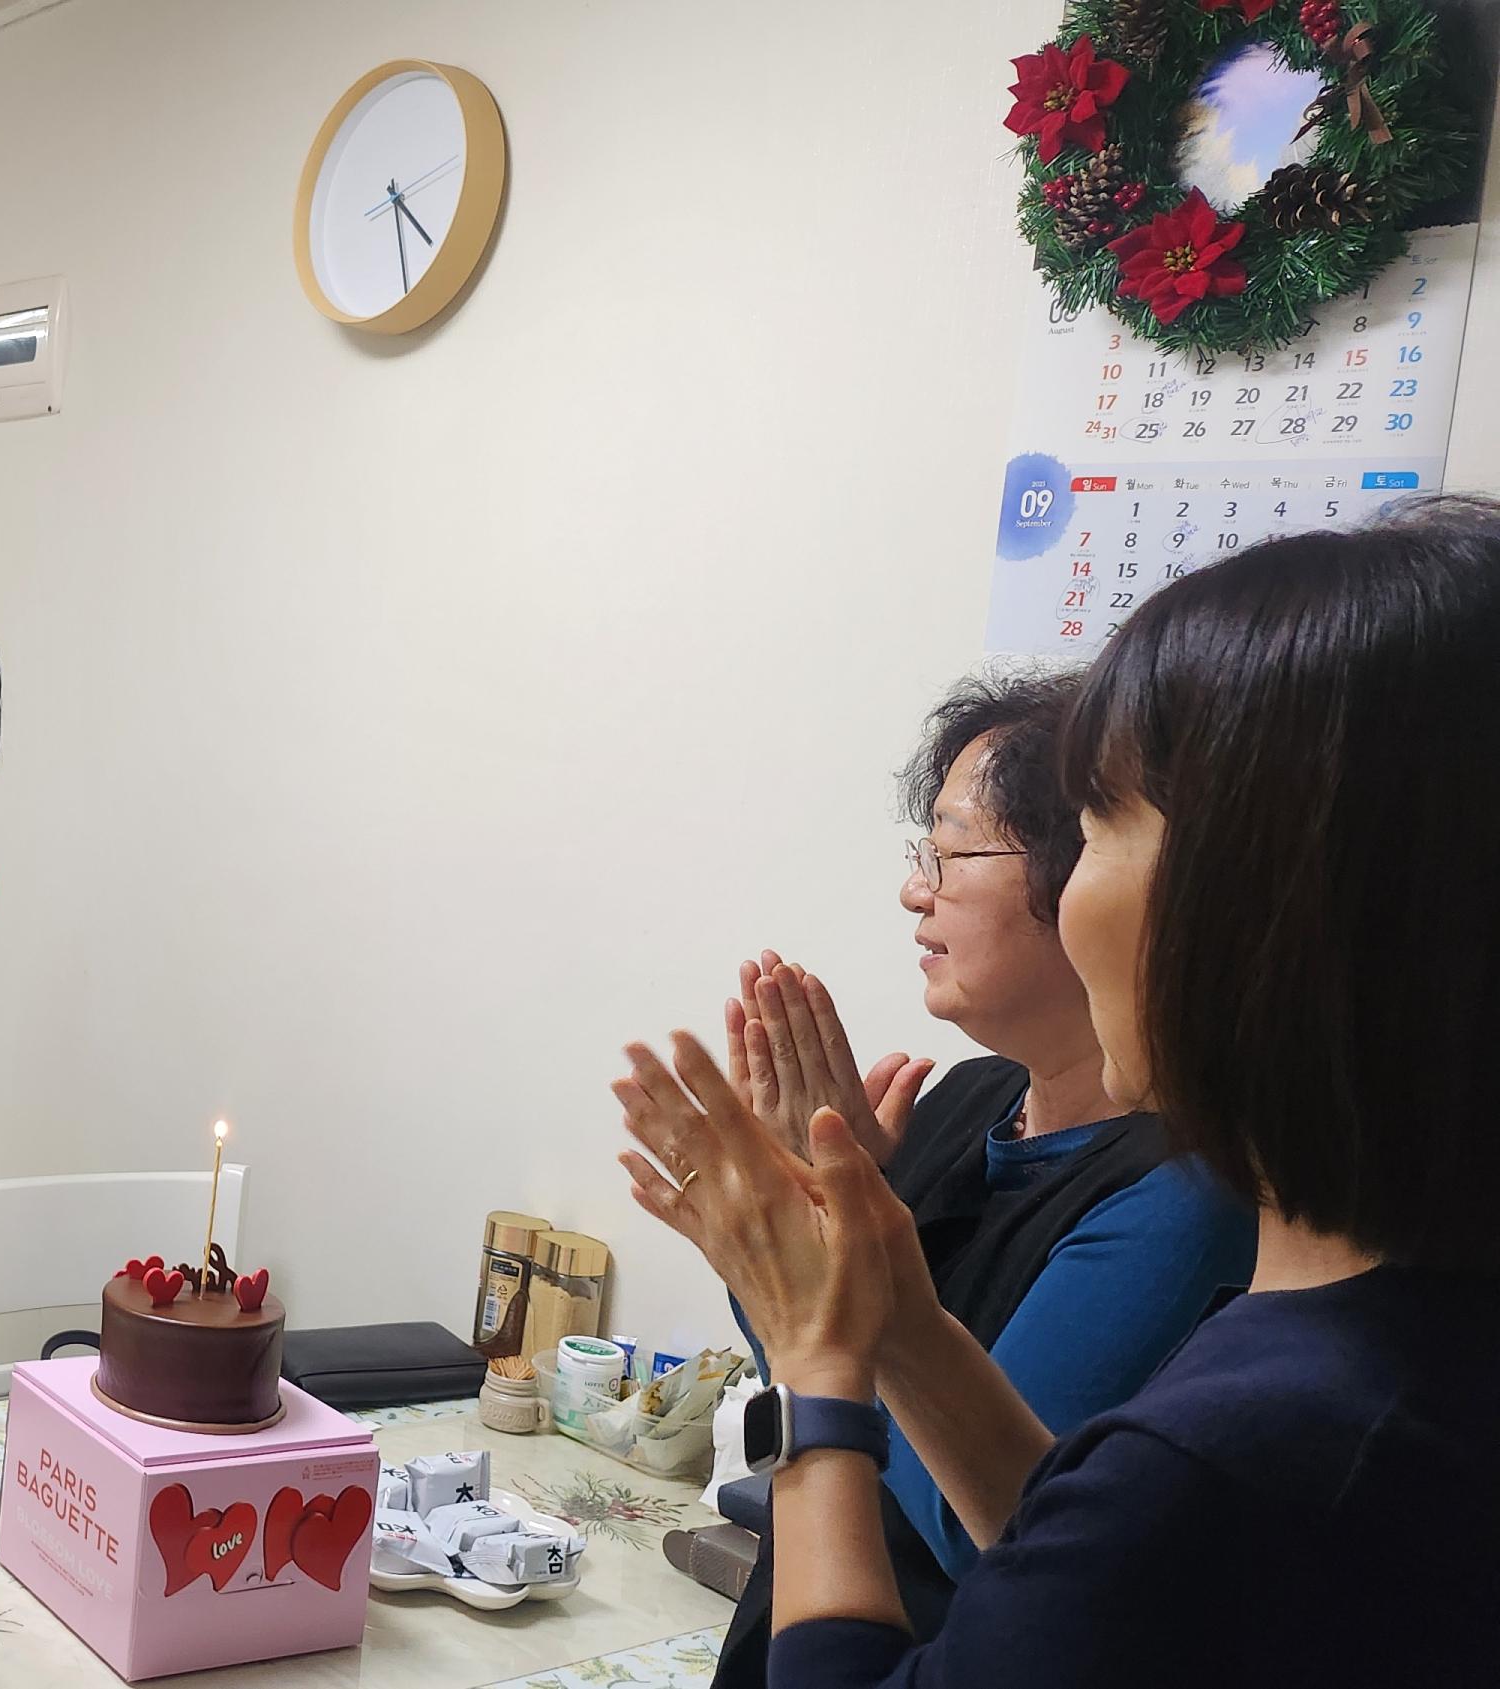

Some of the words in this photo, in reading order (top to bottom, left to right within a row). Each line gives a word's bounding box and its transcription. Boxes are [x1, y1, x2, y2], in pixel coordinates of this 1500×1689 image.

[1411, 278, 1428, 295] 2
[1048, 326, 1075, 336] August
[1353, 316, 1368, 333] 8
[1407, 312, 1422, 329] 9
[1108, 334, 1122, 350] 3
[1102, 364, 1122, 380] 10
[1148, 361, 1167, 378] 11
[1196, 359, 1217, 375] 12
[1243, 355, 1266, 372] 13
[1294, 352, 1316, 370] 14
[1346, 349, 1369, 367] 15
[1399, 345, 1423, 363] 16
[1097, 394, 1118, 410] 17
[1143, 392, 1164, 408] 18
[1190, 390, 1212, 406] 19
[1235, 387, 1260, 404] 20
[1285, 385, 1309, 402] 21
[1336, 382, 1363, 400] 22
[1389, 379, 1418, 397] 23
[1085, 420, 1101, 434] 24
[1101, 426, 1117, 439] 31
[1135, 423, 1160, 439] 25
[1182, 421, 1206, 437] 26
[1230, 419, 1256, 436] 27
[1280, 417, 1306, 434] 28
[1331, 415, 1358, 432] 29
[1384, 413, 1413, 431] 30
[1082, 479, 1092, 491] 일
[1092, 482, 1107, 491] Sun
[1126, 478, 1136, 490] 월
[1137, 482, 1154, 490] Mon
[1173, 478, 1185, 490] 화
[1185, 482, 1199, 490] Tue
[1220, 478, 1231, 490] 수
[1232, 481, 1250, 490] Wed
[1270, 477, 1282, 489] 목
[1283, 480, 1299, 489] Thu
[1324, 476, 1336, 488] 금
[1337, 479, 1348, 488] Fri
[1374, 475, 1387, 487] 토
[1388, 479, 1405, 488] Sat
[1020, 489, 1054, 518] 09
[1132, 502, 1140, 517] 1
[1176, 502, 1189, 518] 2
[1223, 501, 1238, 518] 3
[1273, 501, 1287, 518] 4
[1324, 501, 1339, 518] 5
[1015, 519, 1052, 529] September
[1079, 532, 1091, 547] 7
[1124, 532, 1138, 548] 8
[1172, 533, 1185, 549] 9
[1217, 533, 1239, 549] 10
[1071, 561, 1091, 577] 14
[1117, 562, 1138, 578] 15
[1165, 563, 1185, 579] 16
[1064, 591, 1085, 607] 21
[1109, 592, 1134, 608] 22
[1060, 620, 1082, 636] 28
[40, 1448, 97, 1512] PARIS
[17, 1460, 120, 1566] BAGUETTE
